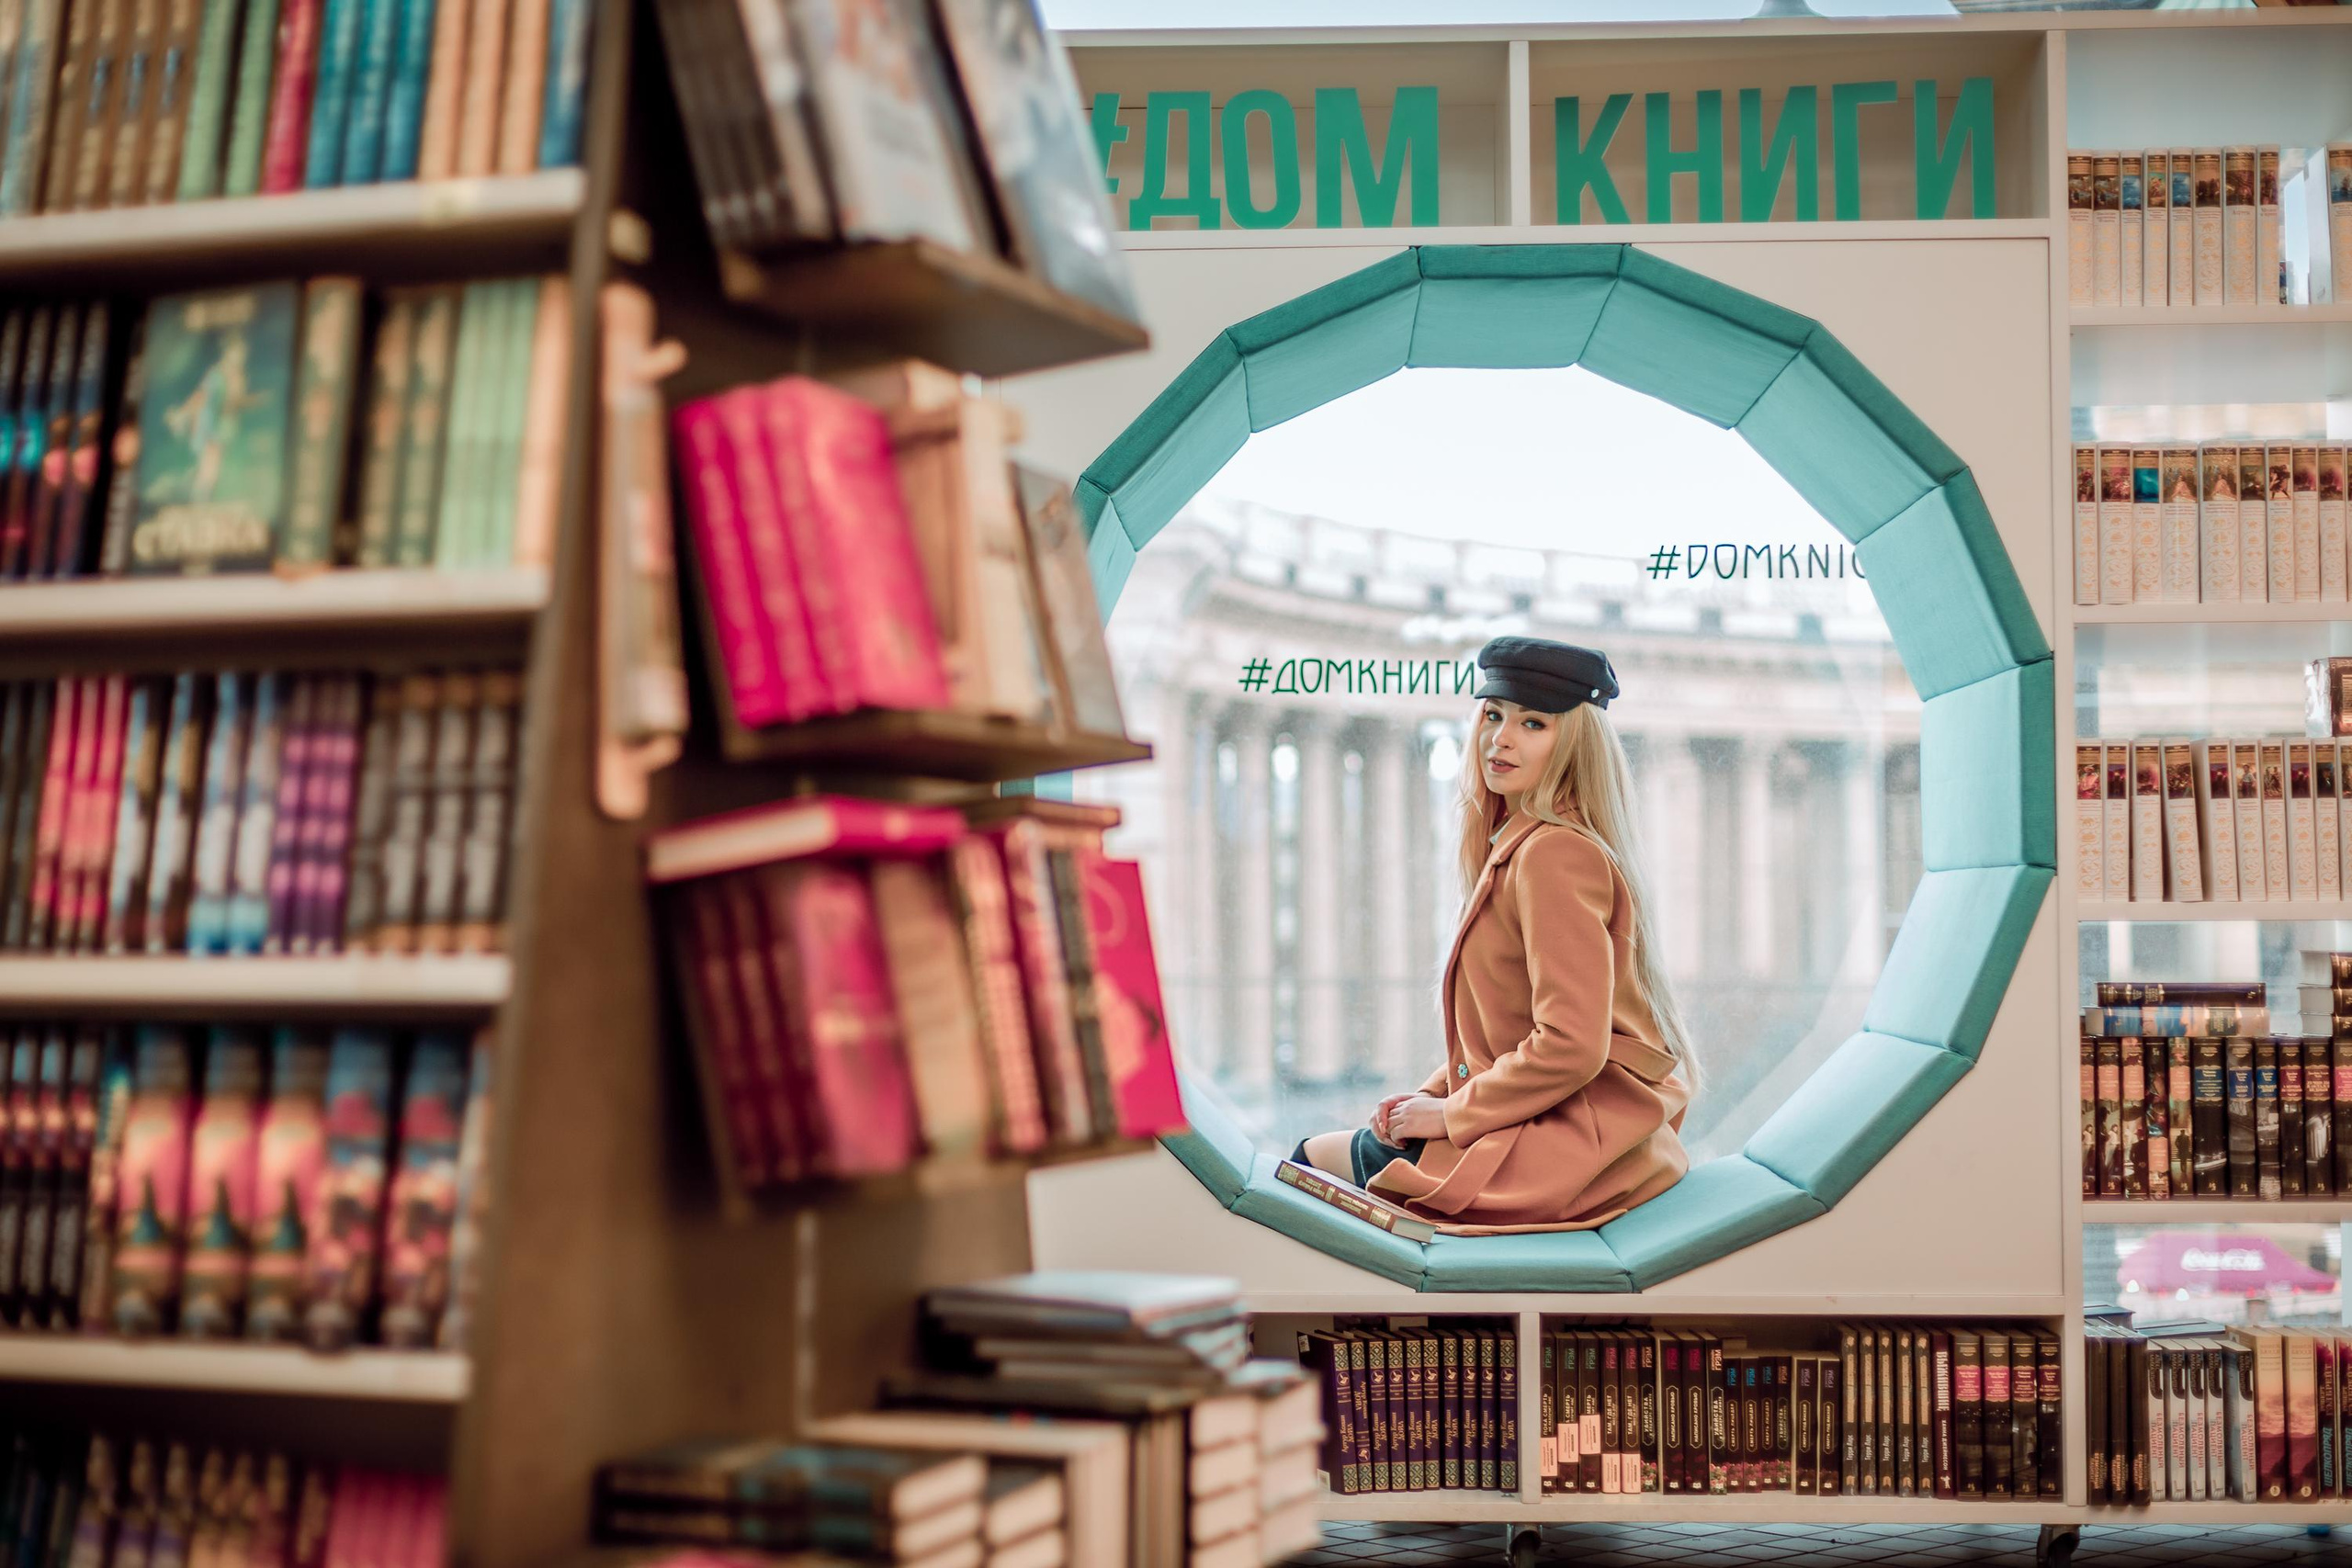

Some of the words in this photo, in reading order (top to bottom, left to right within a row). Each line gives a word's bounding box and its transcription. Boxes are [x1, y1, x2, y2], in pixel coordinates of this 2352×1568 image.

[1555, 77, 1996, 226] КНИГИ
[1238, 658, 1475, 695] #ДОМКНИГИ
[1936, 1351, 1950, 1411] ВЫЖИВШИЕ
[2324, 1427, 2333, 1486] ШЕЛКОПРЯД
